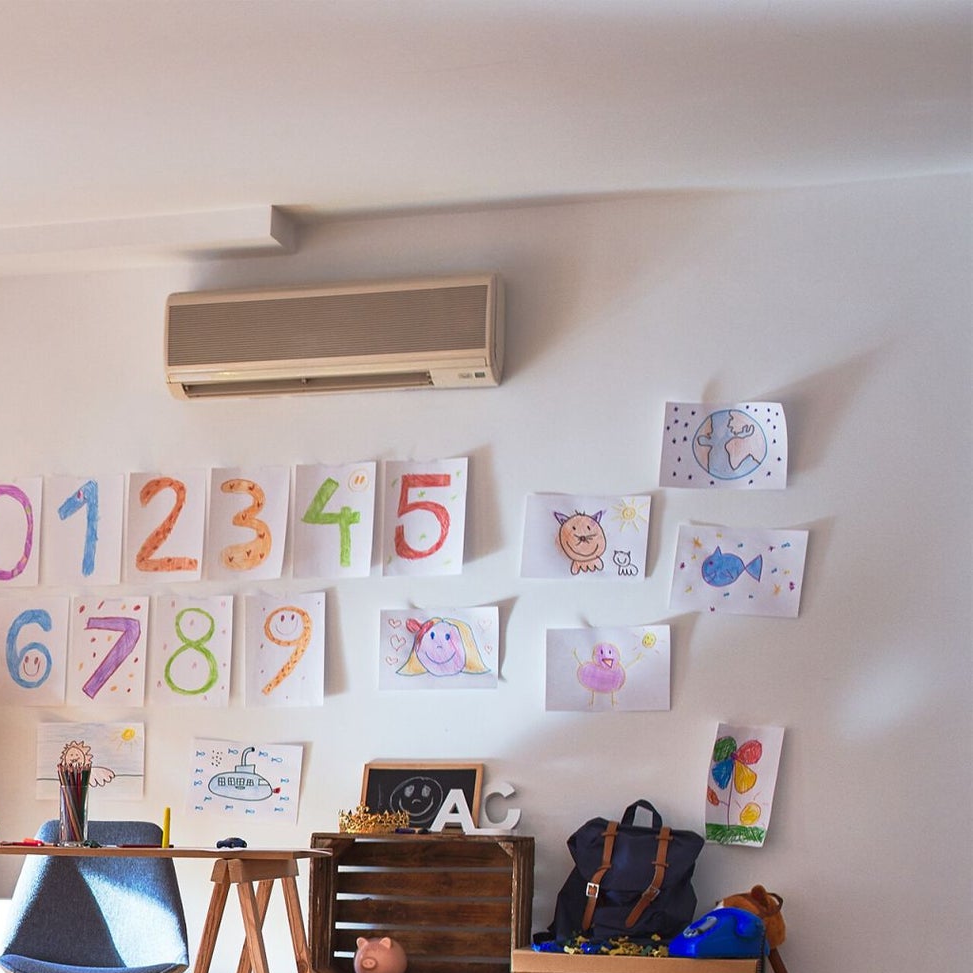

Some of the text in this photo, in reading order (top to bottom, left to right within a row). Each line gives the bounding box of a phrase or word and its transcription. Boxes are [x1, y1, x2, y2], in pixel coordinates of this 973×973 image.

[57, 479, 98, 577] 1
[136, 477, 198, 572] 2
[221, 478, 272, 570] 3
[301, 477, 361, 567] 4
[394, 474, 451, 560] 5
[6, 605, 313, 699] 6 7 8 9
